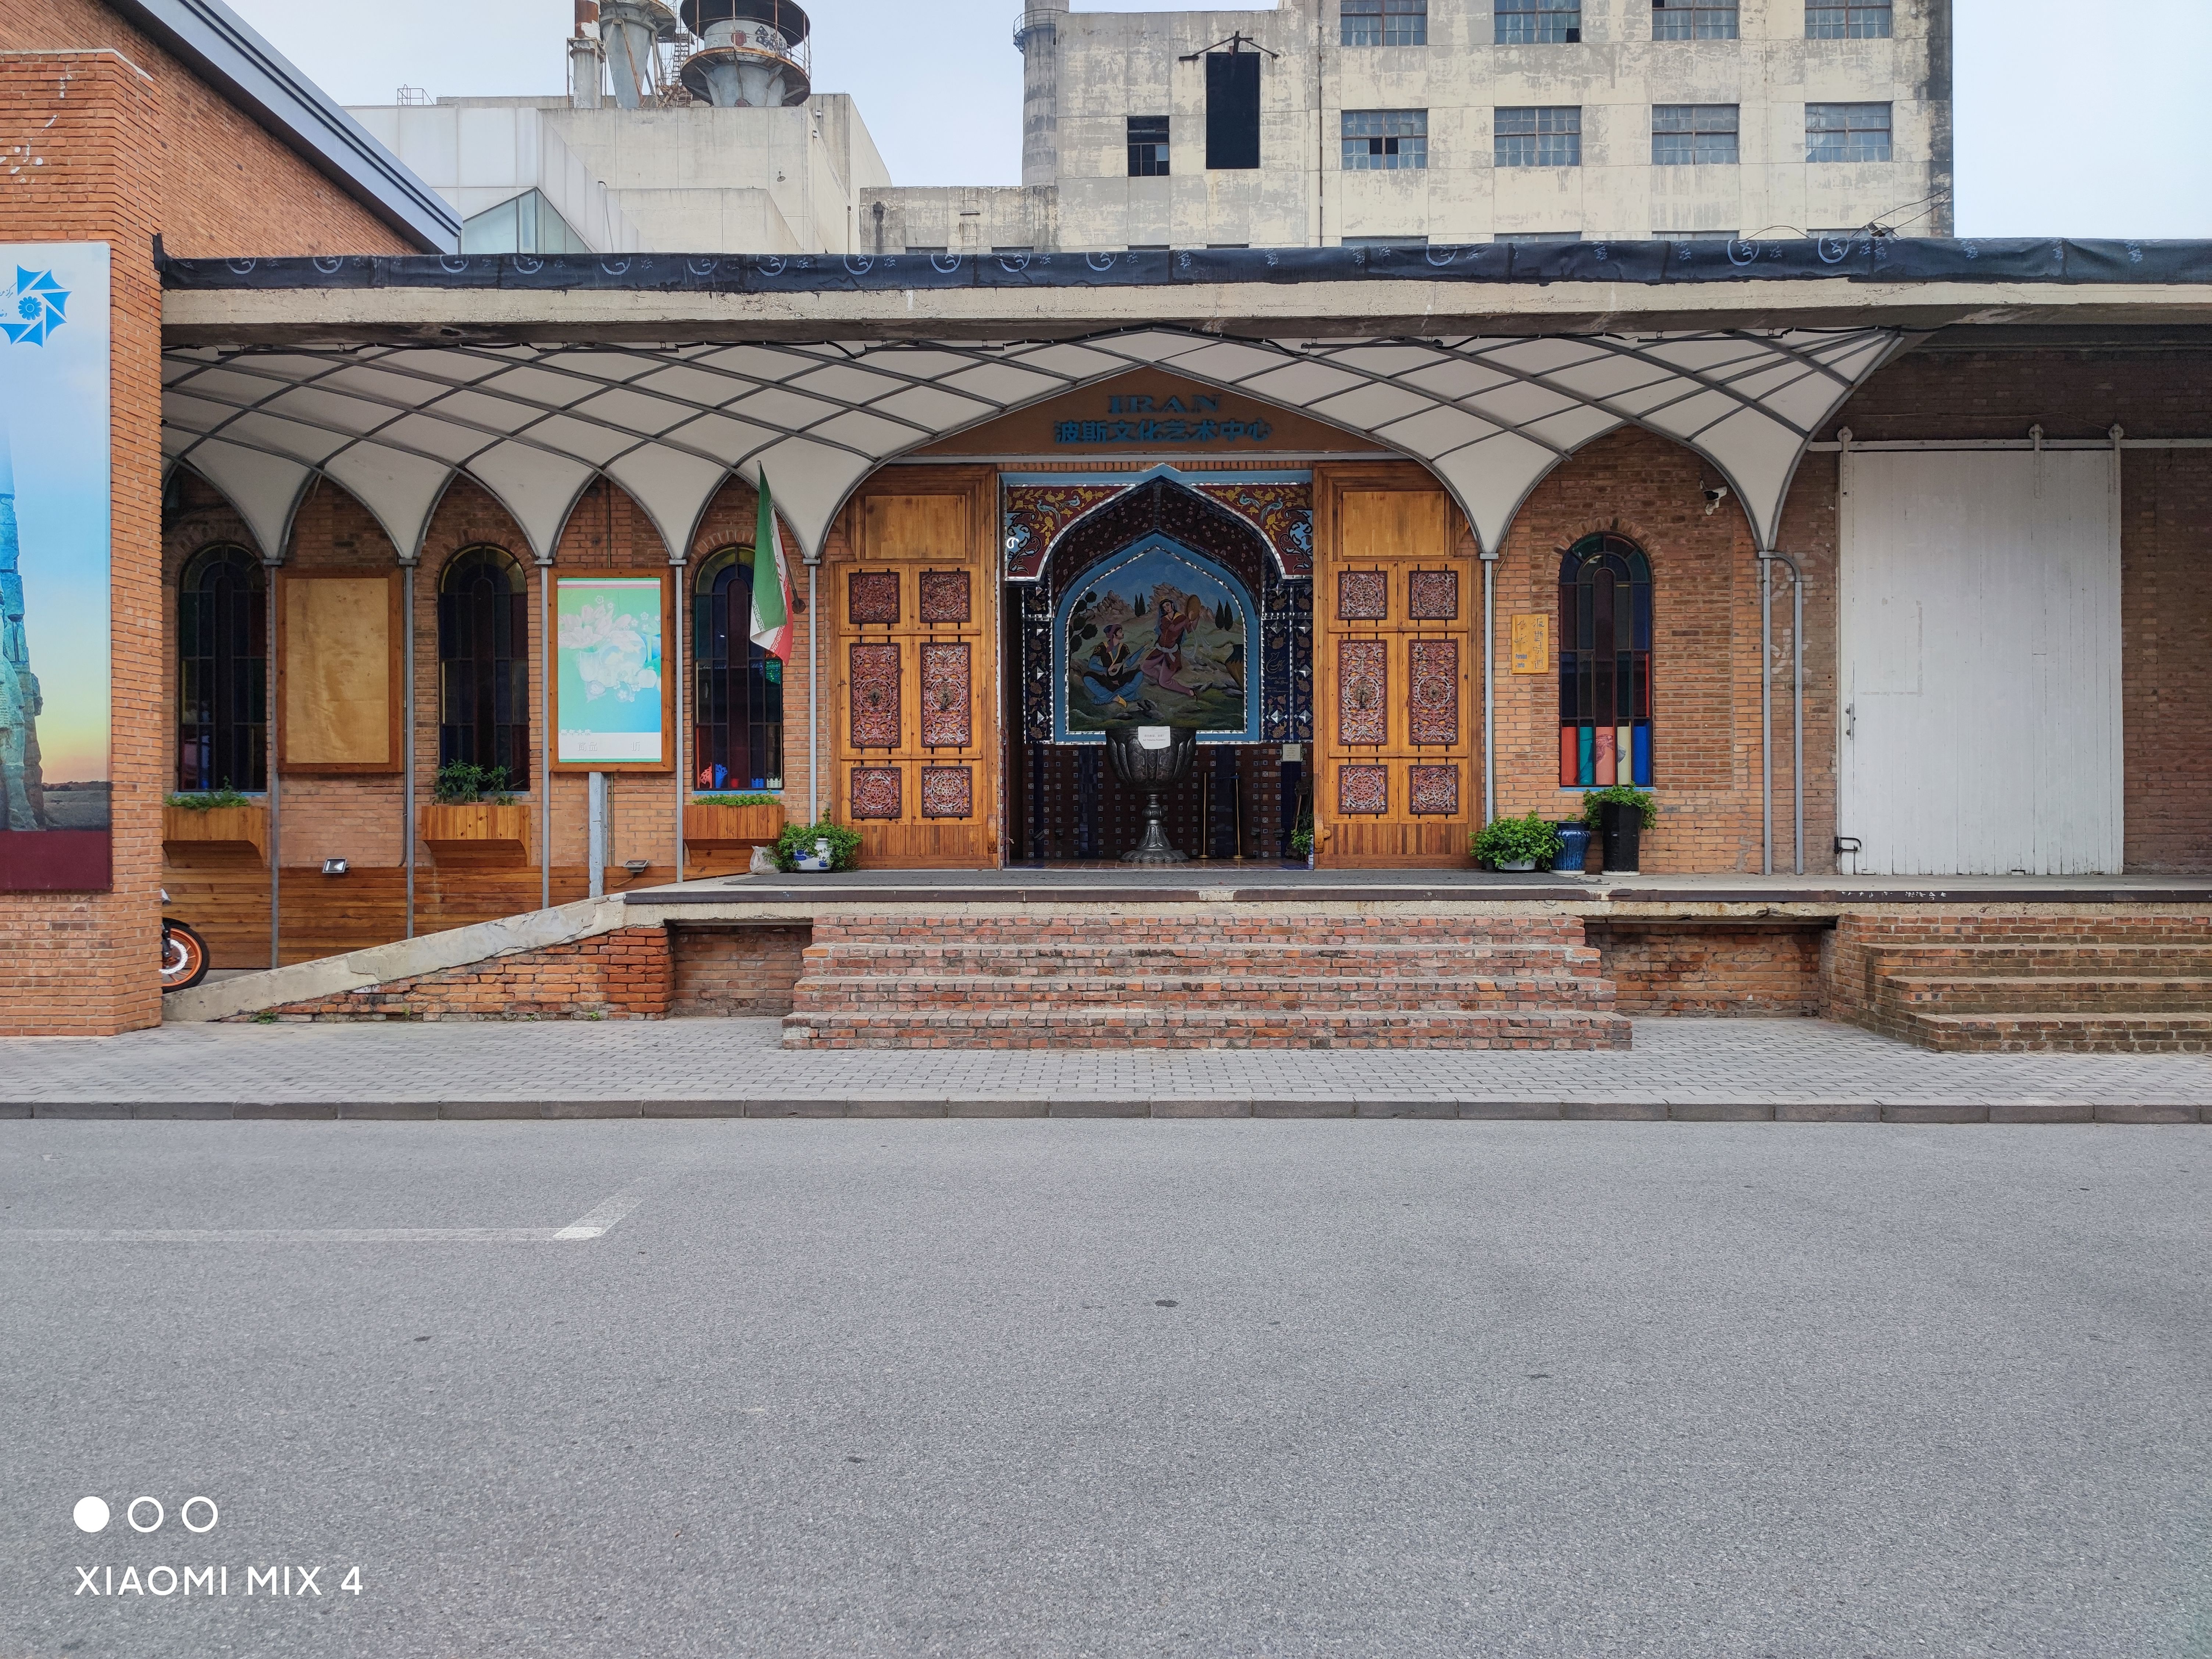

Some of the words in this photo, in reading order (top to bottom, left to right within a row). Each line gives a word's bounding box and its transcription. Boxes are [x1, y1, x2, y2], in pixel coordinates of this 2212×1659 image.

[1108, 394, 1222, 414] IRAN
[1055, 419, 1272, 443] 波斯文化艺术中心
[1532, 616, 1545, 670] 波斯味道
[577, 742, 597, 752] 商品
